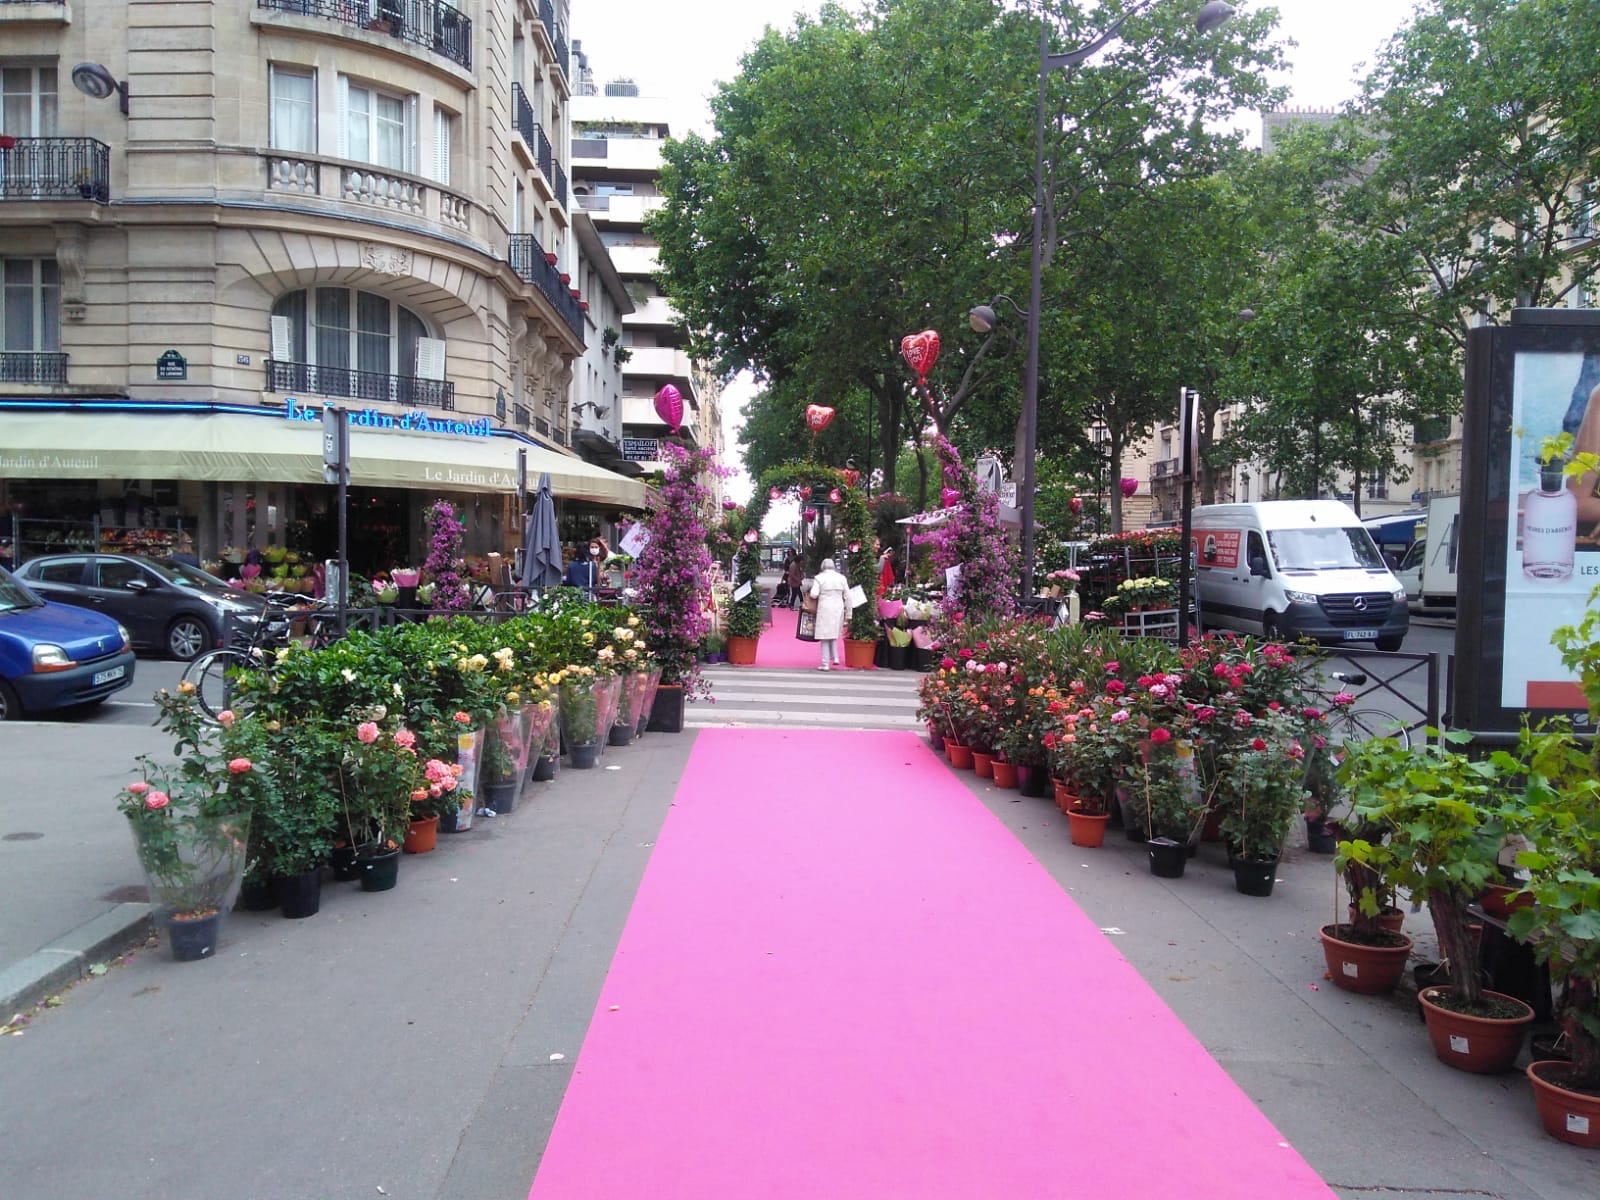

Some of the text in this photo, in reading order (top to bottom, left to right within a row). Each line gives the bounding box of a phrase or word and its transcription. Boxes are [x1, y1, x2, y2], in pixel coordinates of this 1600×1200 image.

[238, 355, 249, 364] 56
[285, 398, 315, 421] Le
[400, 410, 491, 438] d'Auteuil
[39, 455, 99, 469] d'Auteuil
[425, 467, 442, 481] Le
[446, 469, 485, 484] Jardin
[1580, 566, 1599, 575] LES
